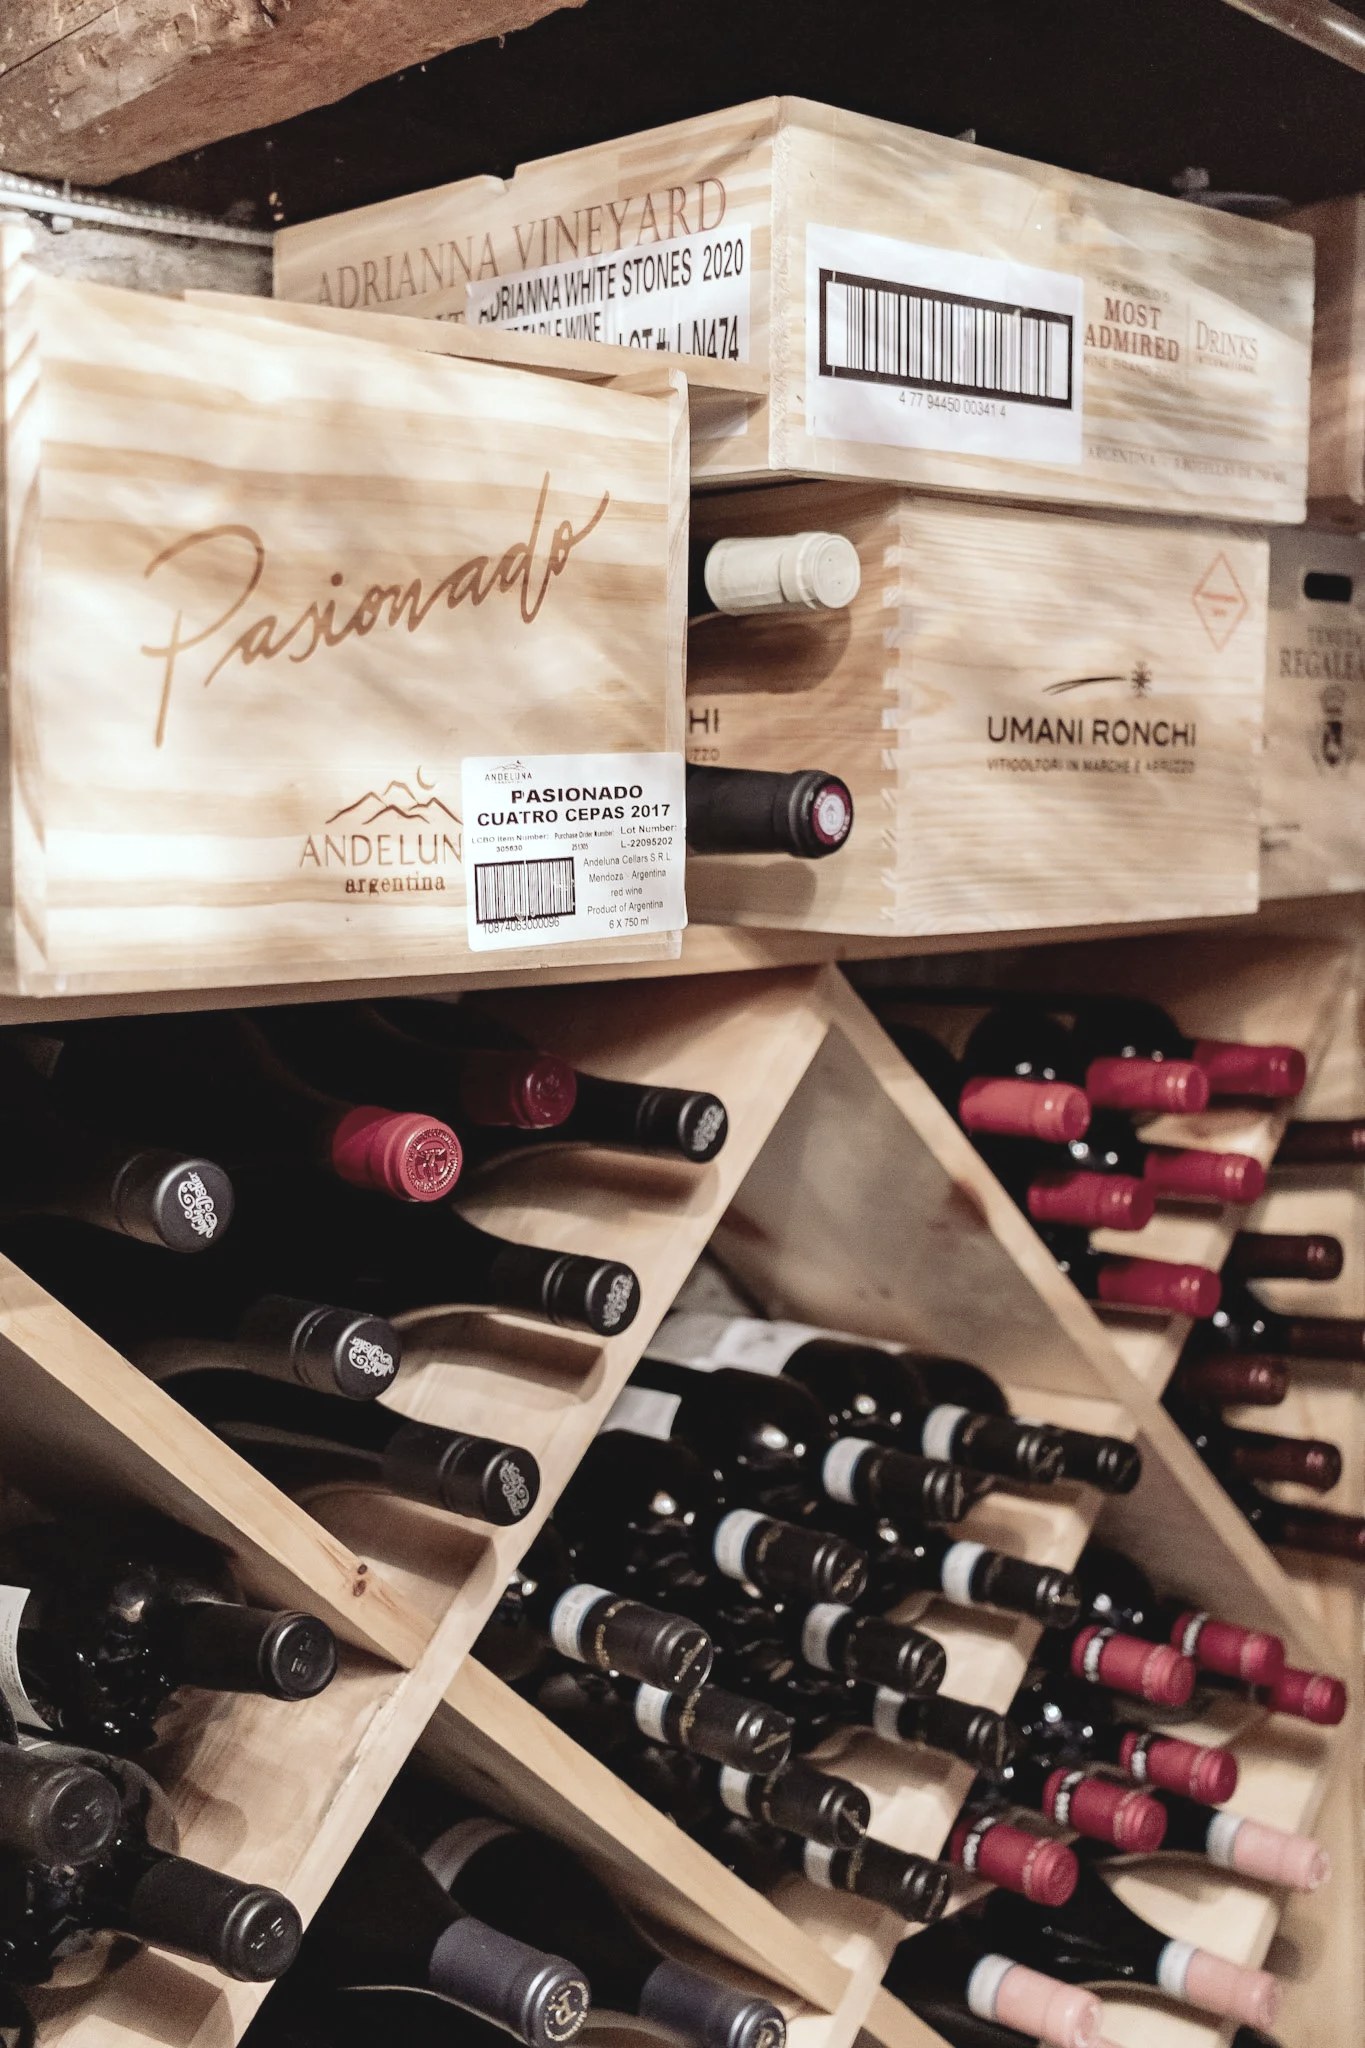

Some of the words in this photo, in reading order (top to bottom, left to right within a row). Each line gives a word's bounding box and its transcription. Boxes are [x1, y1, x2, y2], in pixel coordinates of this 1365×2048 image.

[318, 231, 500, 309] ADRIANNA
[513, 177, 727, 270] VINEYARD
[479, 275, 561, 324] ADRIANNA
[564, 263, 616, 307] WHITE
[622, 247, 692, 298] STONES
[703, 238, 744, 282] 2020
[1104, 297, 1162, 331] MOST
[1084, 323, 1180, 363] ADMIRED
[899, 391, 906, 404] 4
[910, 391, 923, 408] 77
[927, 393, 961, 413] 94450
[964, 400, 996, 417] 00341
[1000, 405, 1006, 418] 4
[141, 470, 610, 749] Pasionado
[987, 716, 1084, 744] UMANI
[1092, 719, 1196, 748] RONCHI
[485, 772, 532, 781] ANDELUNA
[511, 785, 643, 804] PASIONADO
[477, 809, 558, 827] CUATRO
[565, 806, 625, 822] CEPAS
[631, 804, 670, 818] 2017
[620, 826, 636, 835] Lot
[638, 824, 678, 834] Number:
[299, 832, 463, 868] ANDELUN
[620, 837, 673, 848] L-22095202
[583, 856, 620, 867] Andeluna
[622, 853, 648, 865] Cellars
[345, 870, 446, 895] argentina
[588, 872, 624, 883] Mendoza
[631, 868, 667, 881] Argentina
[610, 887, 623, 897] red
[625, 885, 643, 896] wine
[587, 904, 617, 915] Product
[619, 902, 627, 913] of
[628, 899, 664, 913] Argentina
[608, 919, 615, 930] 6
[624, 917, 639, 928] 750
[640, 915, 649, 926] ml
